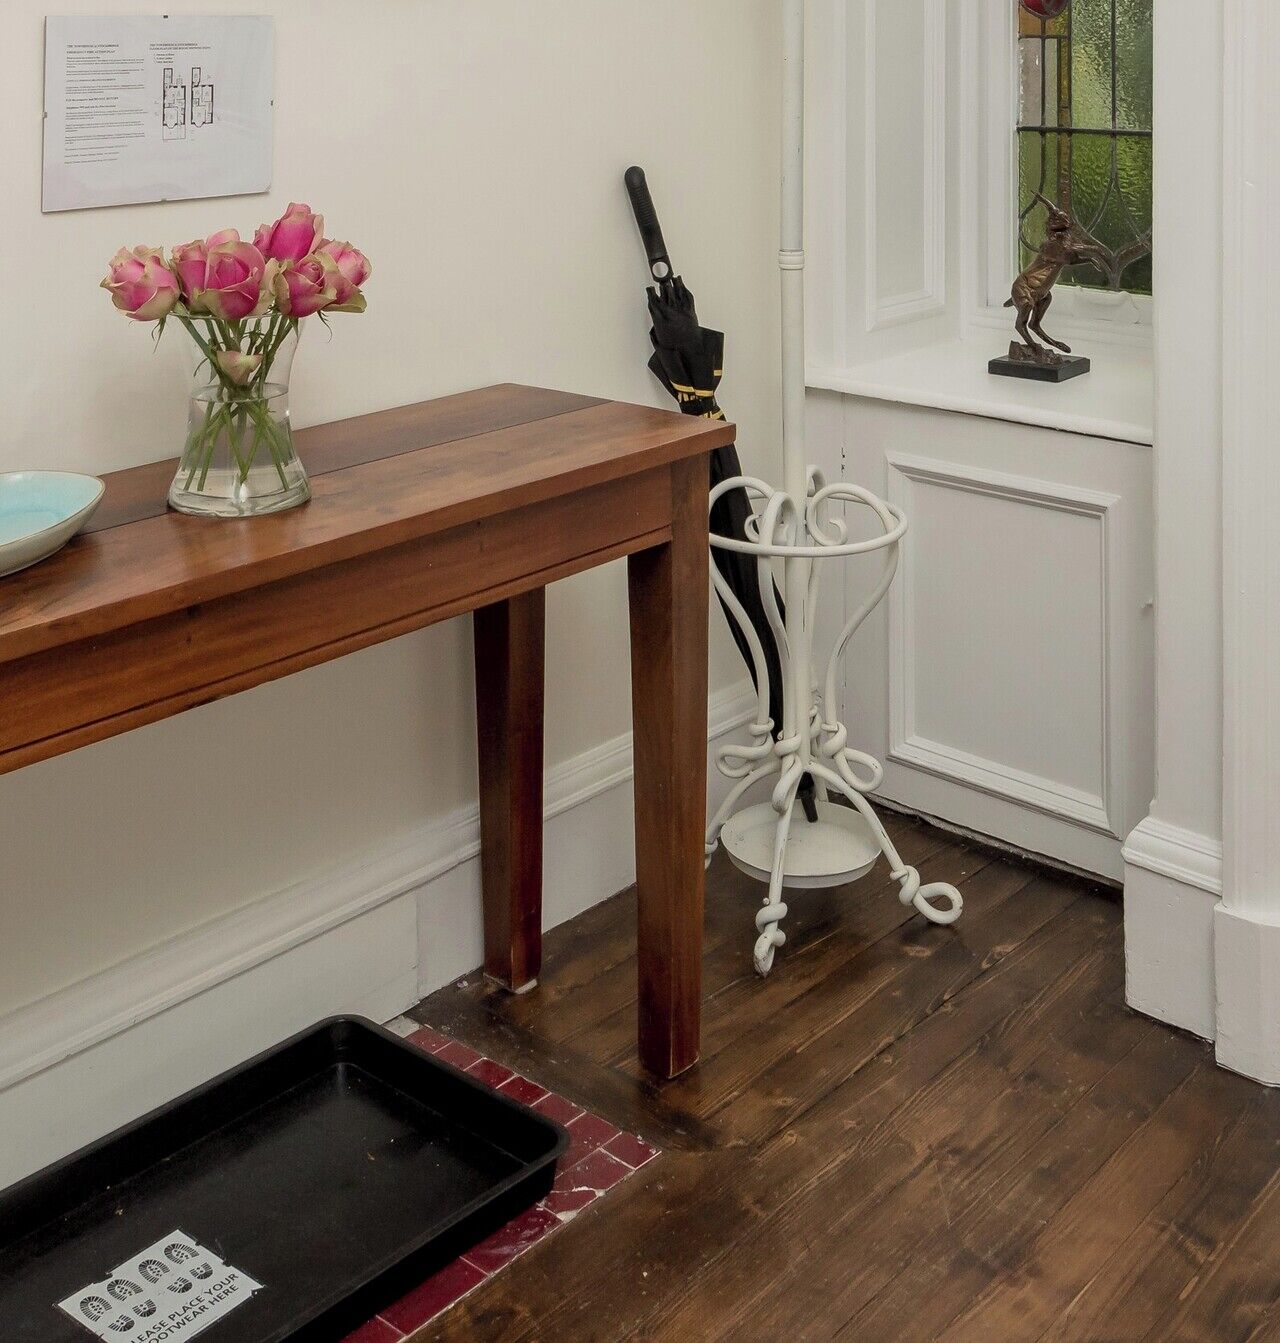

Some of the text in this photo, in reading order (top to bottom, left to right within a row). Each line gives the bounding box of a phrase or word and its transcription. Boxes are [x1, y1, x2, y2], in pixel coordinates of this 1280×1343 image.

[131, 1273, 239, 1343] EASE PLACE YOUR
[148, 1284, 239, 1343] OOTWEAR HERE
